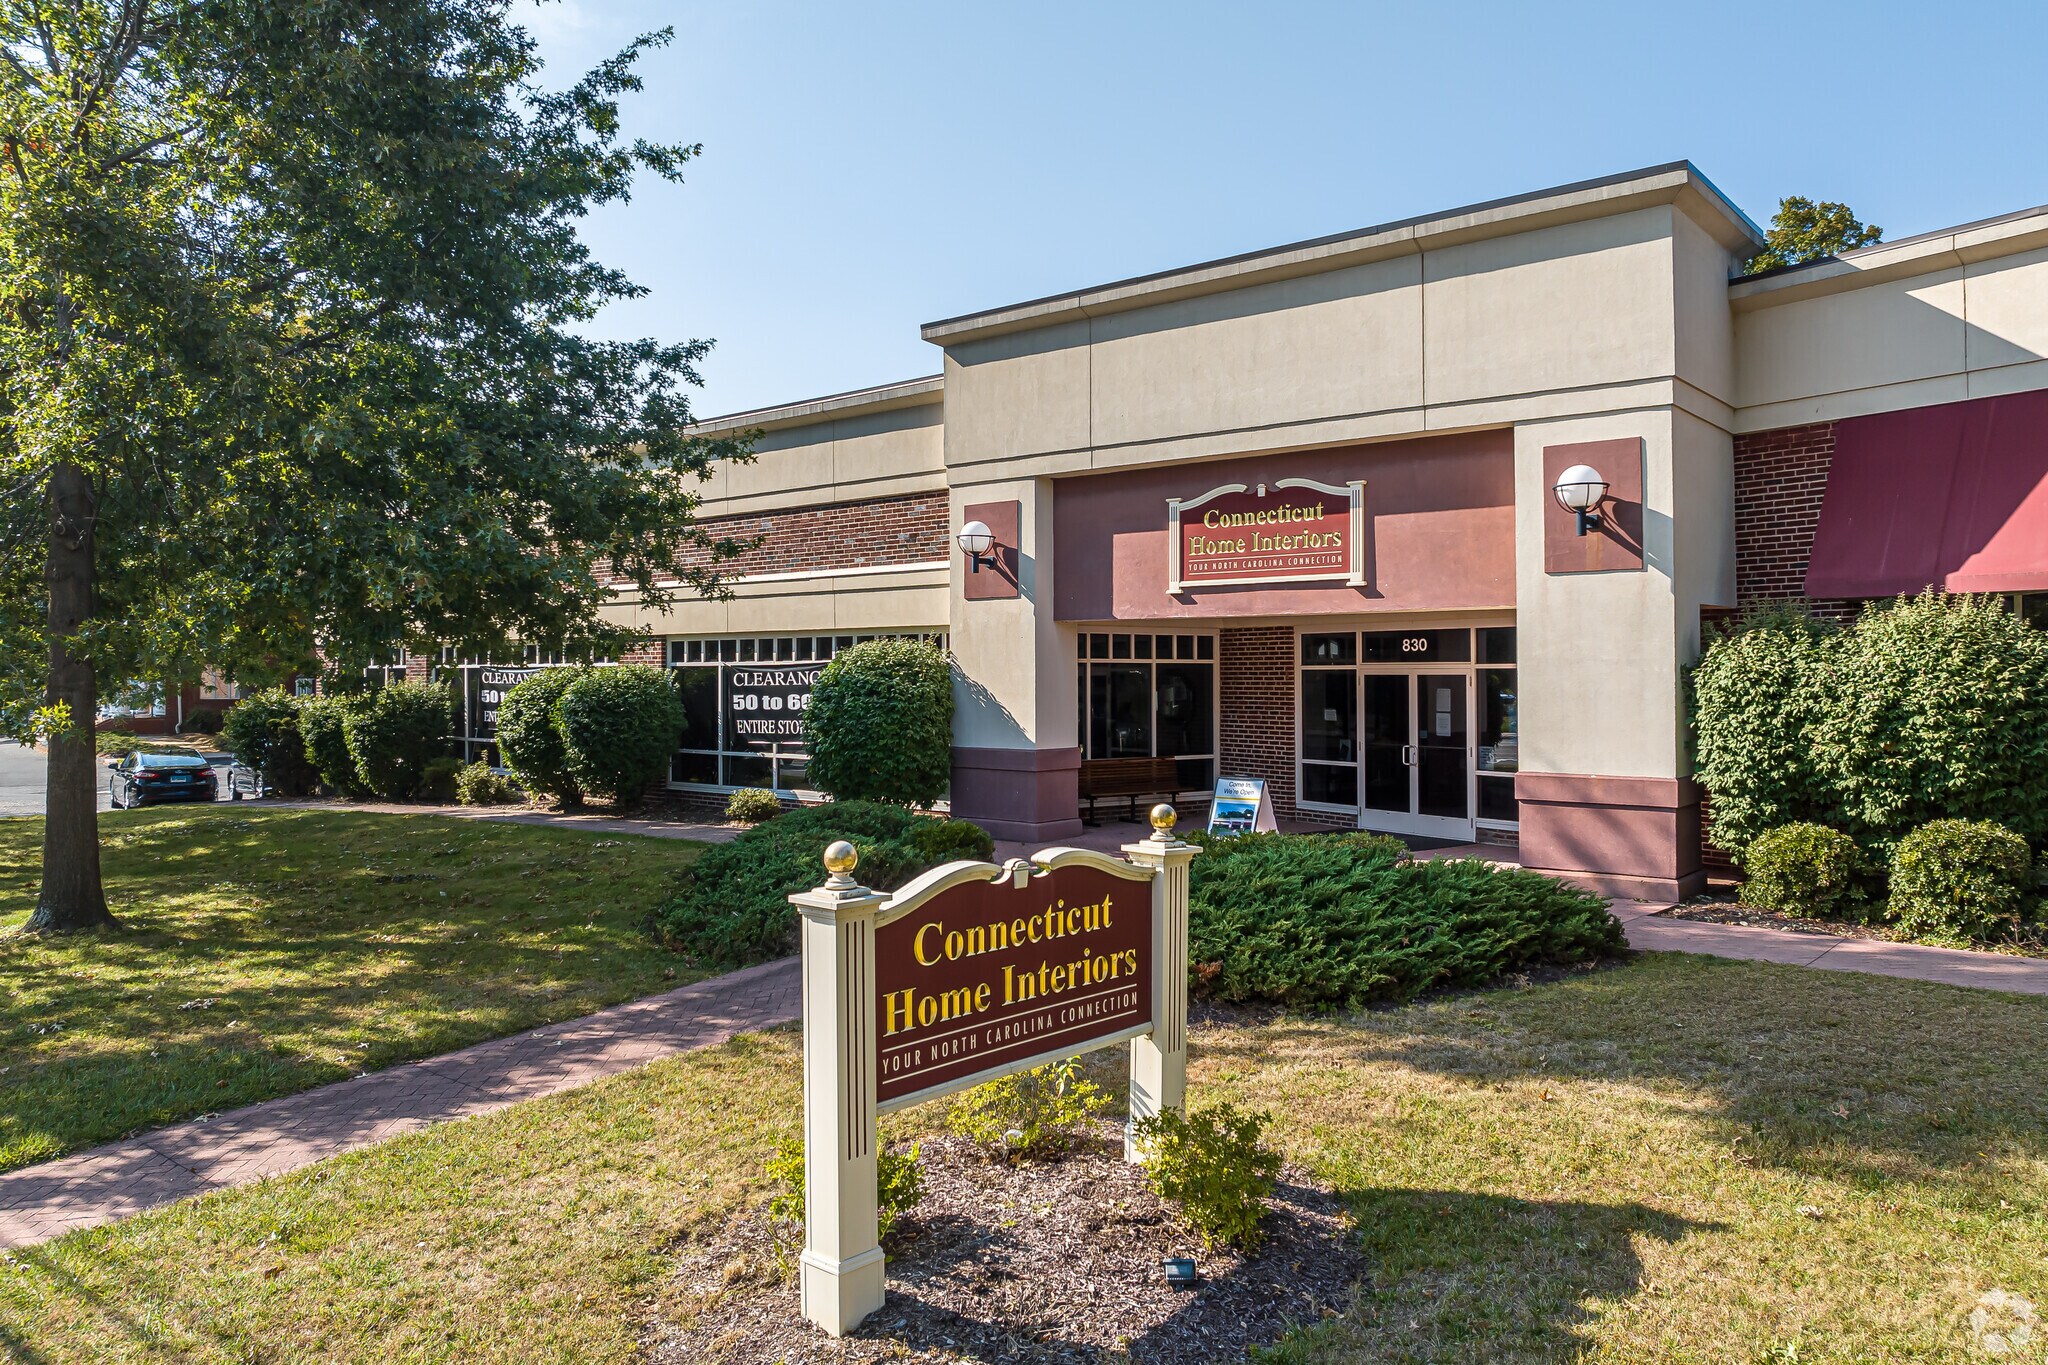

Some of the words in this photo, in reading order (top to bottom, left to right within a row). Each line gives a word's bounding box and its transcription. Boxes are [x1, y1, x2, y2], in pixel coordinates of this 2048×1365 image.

[1203, 501, 1325, 529] Connecticut
[1189, 535, 1246, 556] Home
[1251, 528, 1343, 552] Interiors
[1188, 563, 1208, 572] YOUR
[1212, 561, 1238, 570] NORTH
[1242, 558, 1283, 568] CAROLINA
[1287, 555, 1343, 566] CONNECTION
[1402, 638, 1428, 652] 830
[481, 689, 499, 703] 50
[732, 694, 759, 710] 50
[762, 695, 783, 710] to
[736, 719, 776, 734] ENTIRE
[913, 893, 1113, 967] Connecticut
[882, 981, 991, 1038] Home
[1001, 947, 1137, 1007] Interiors
[882, 1049, 921, 1074] YOUR
[931, 1033, 977, 1060] NORTH
[986, 1014, 1053, 1044] CAROLINA
[1061, 991, 1138, 1024] CONNECTION
